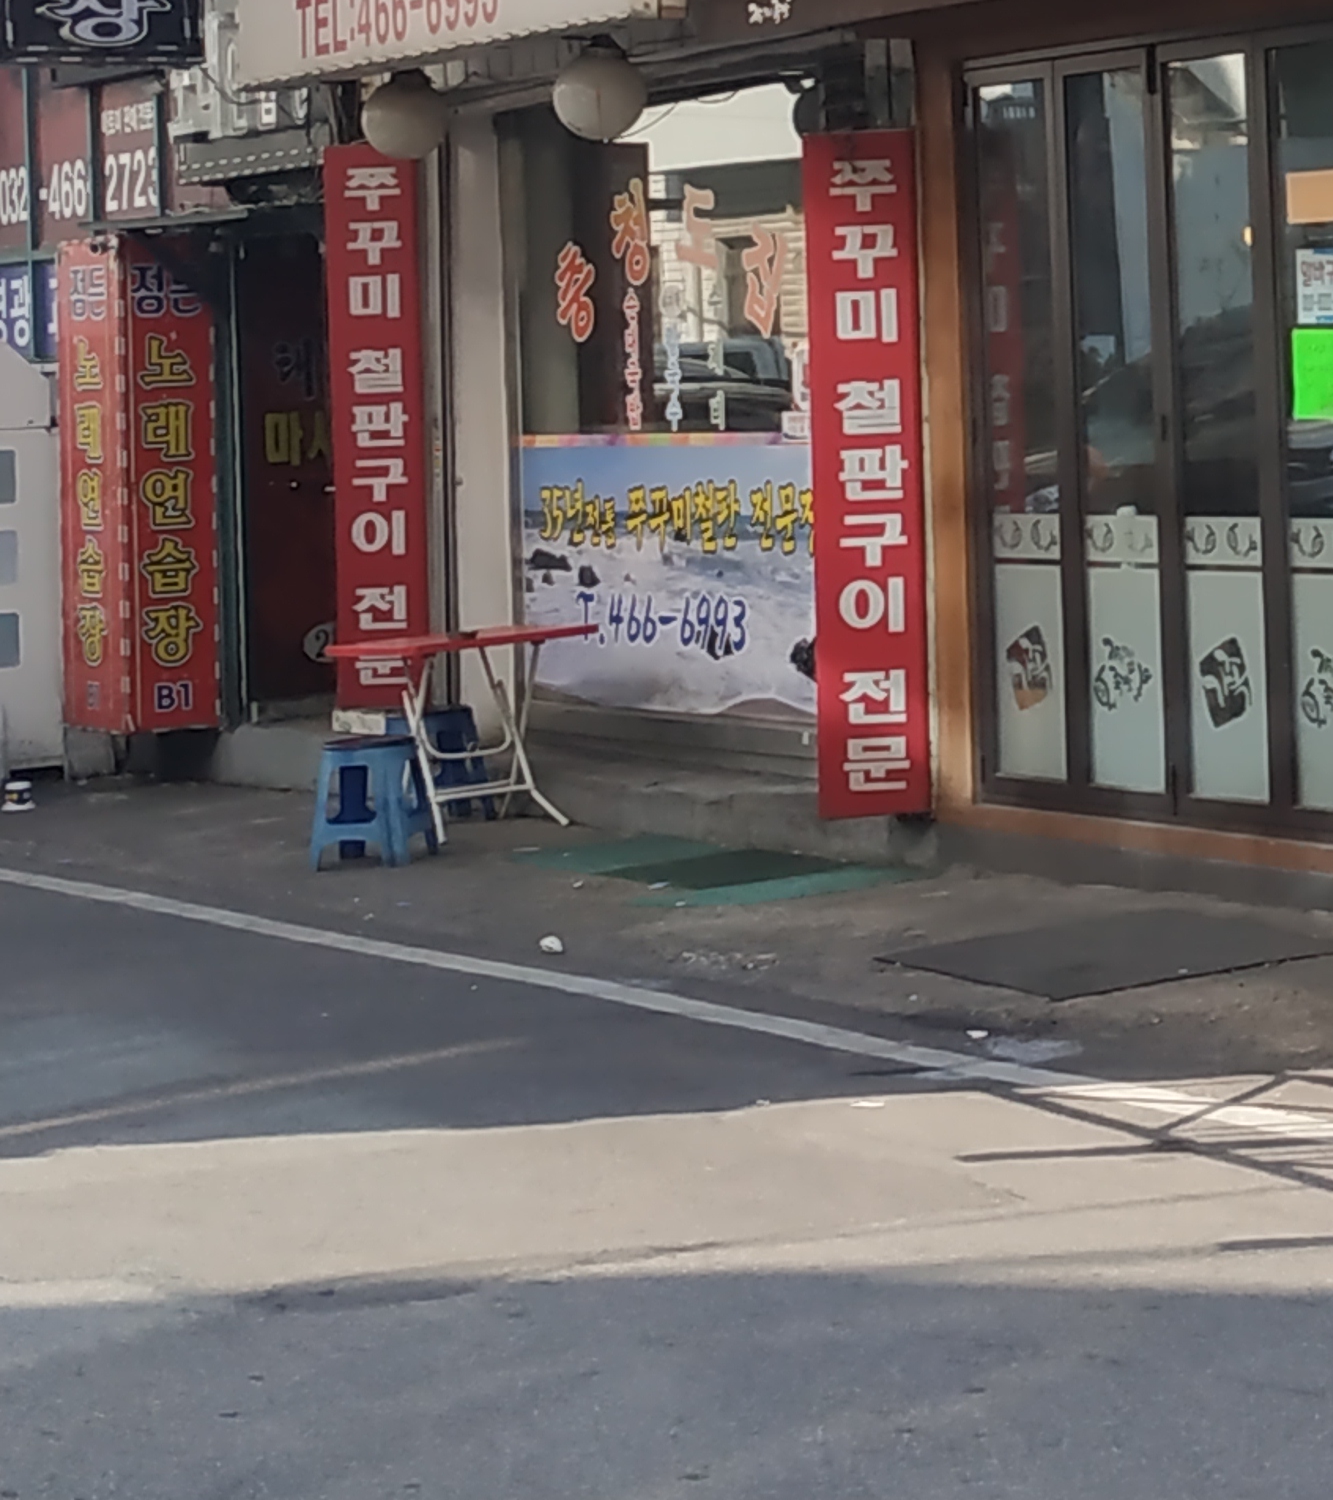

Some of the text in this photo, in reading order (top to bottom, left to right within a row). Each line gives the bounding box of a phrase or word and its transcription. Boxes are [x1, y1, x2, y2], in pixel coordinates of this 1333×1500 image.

[343, 166, 403, 319] 쭈꾸미
[555, 177, 789, 342] 충청도집
[138, 332, 202, 669] 노래연습장
[346, 348, 409, 557] 철판구이
[828, 158, 911, 792] 쭈꾸미 철판구이 전문
[154, 680, 193, 711] B1
